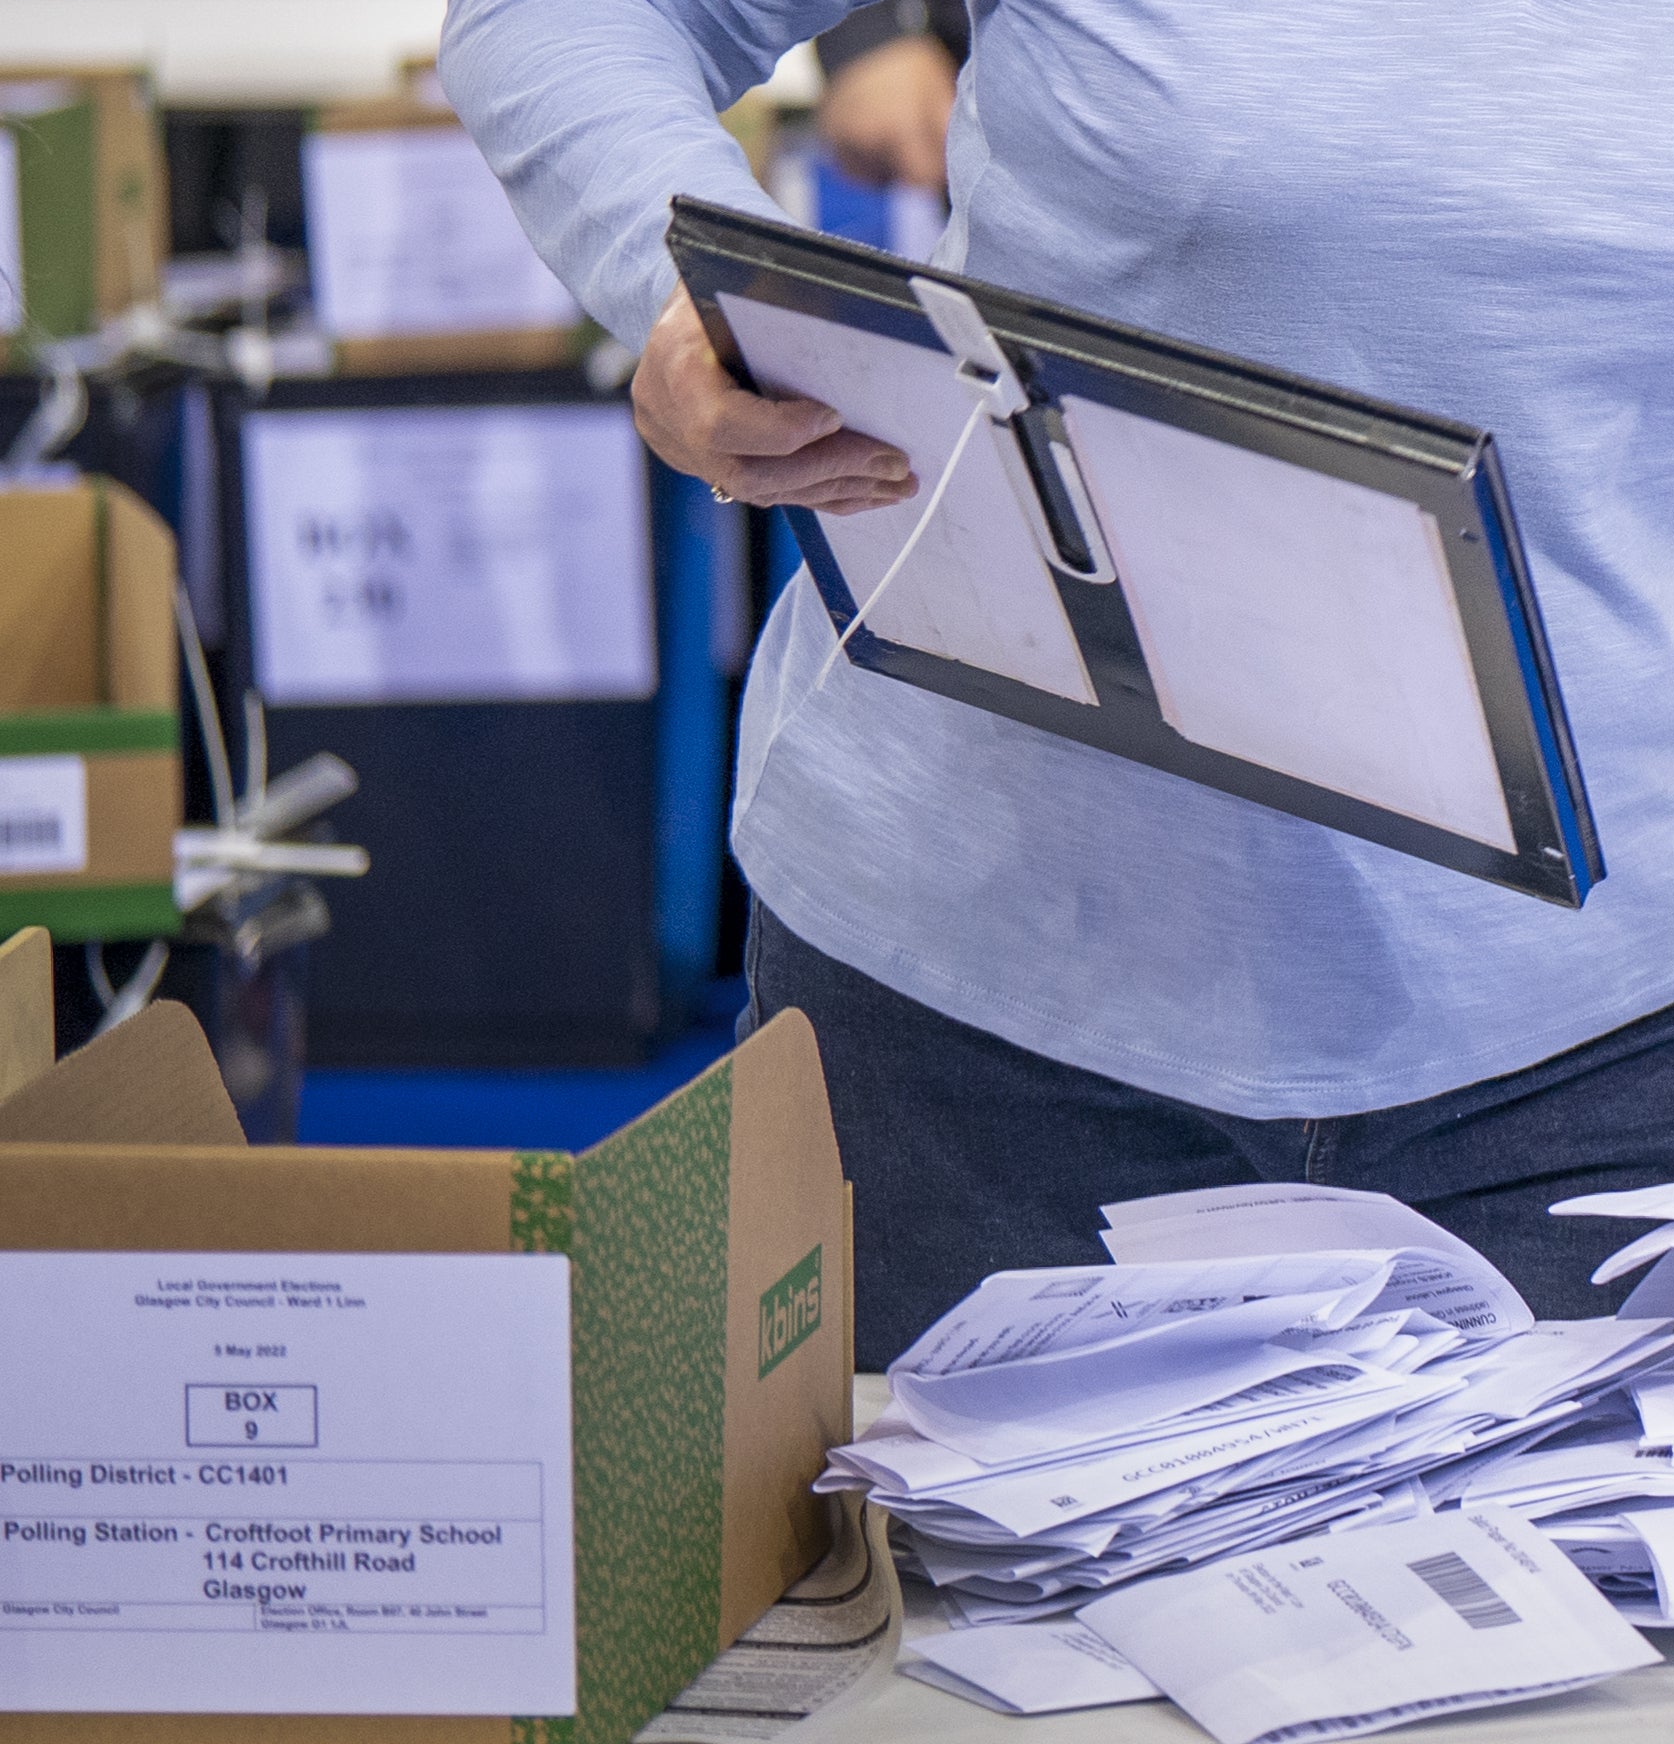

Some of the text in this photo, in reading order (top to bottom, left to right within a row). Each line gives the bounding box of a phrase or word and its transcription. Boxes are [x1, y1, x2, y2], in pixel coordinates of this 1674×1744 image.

[158, 1279, 342, 1292] Local Government Elections
[135, 1295, 191, 1308] Glasgow
[196, 1295, 221, 1308] City
[225, 1295, 275, 1307] Council
[287, 1295, 322, 1307] Ward
[762, 1275, 819, 1367] kbins
[225, 1345, 251, 1358] May
[256, 1345, 287, 1357] 2022
[224, 1391, 279, 1412] BOX
[244, 1420, 258, 1441] 9
[1, 1464, 83, 1489] Polling
[91, 1464, 176, 1485] District
[199, 1464, 288, 1486] CC1401
[4, 1521, 87, 1546] Polling
[95, 1522, 178, 1543] Station
[206, 1522, 312, 1544] Croftfoot
[319, 1523, 411, 1548] Primary
[420, 1524, 502, 1545] School
[204, 1552, 415, 1573] 114 Crofthill Road
[204, 1579, 307, 1605] Glasgow
[3, 1602, 119, 1616] Glasgow City Council
